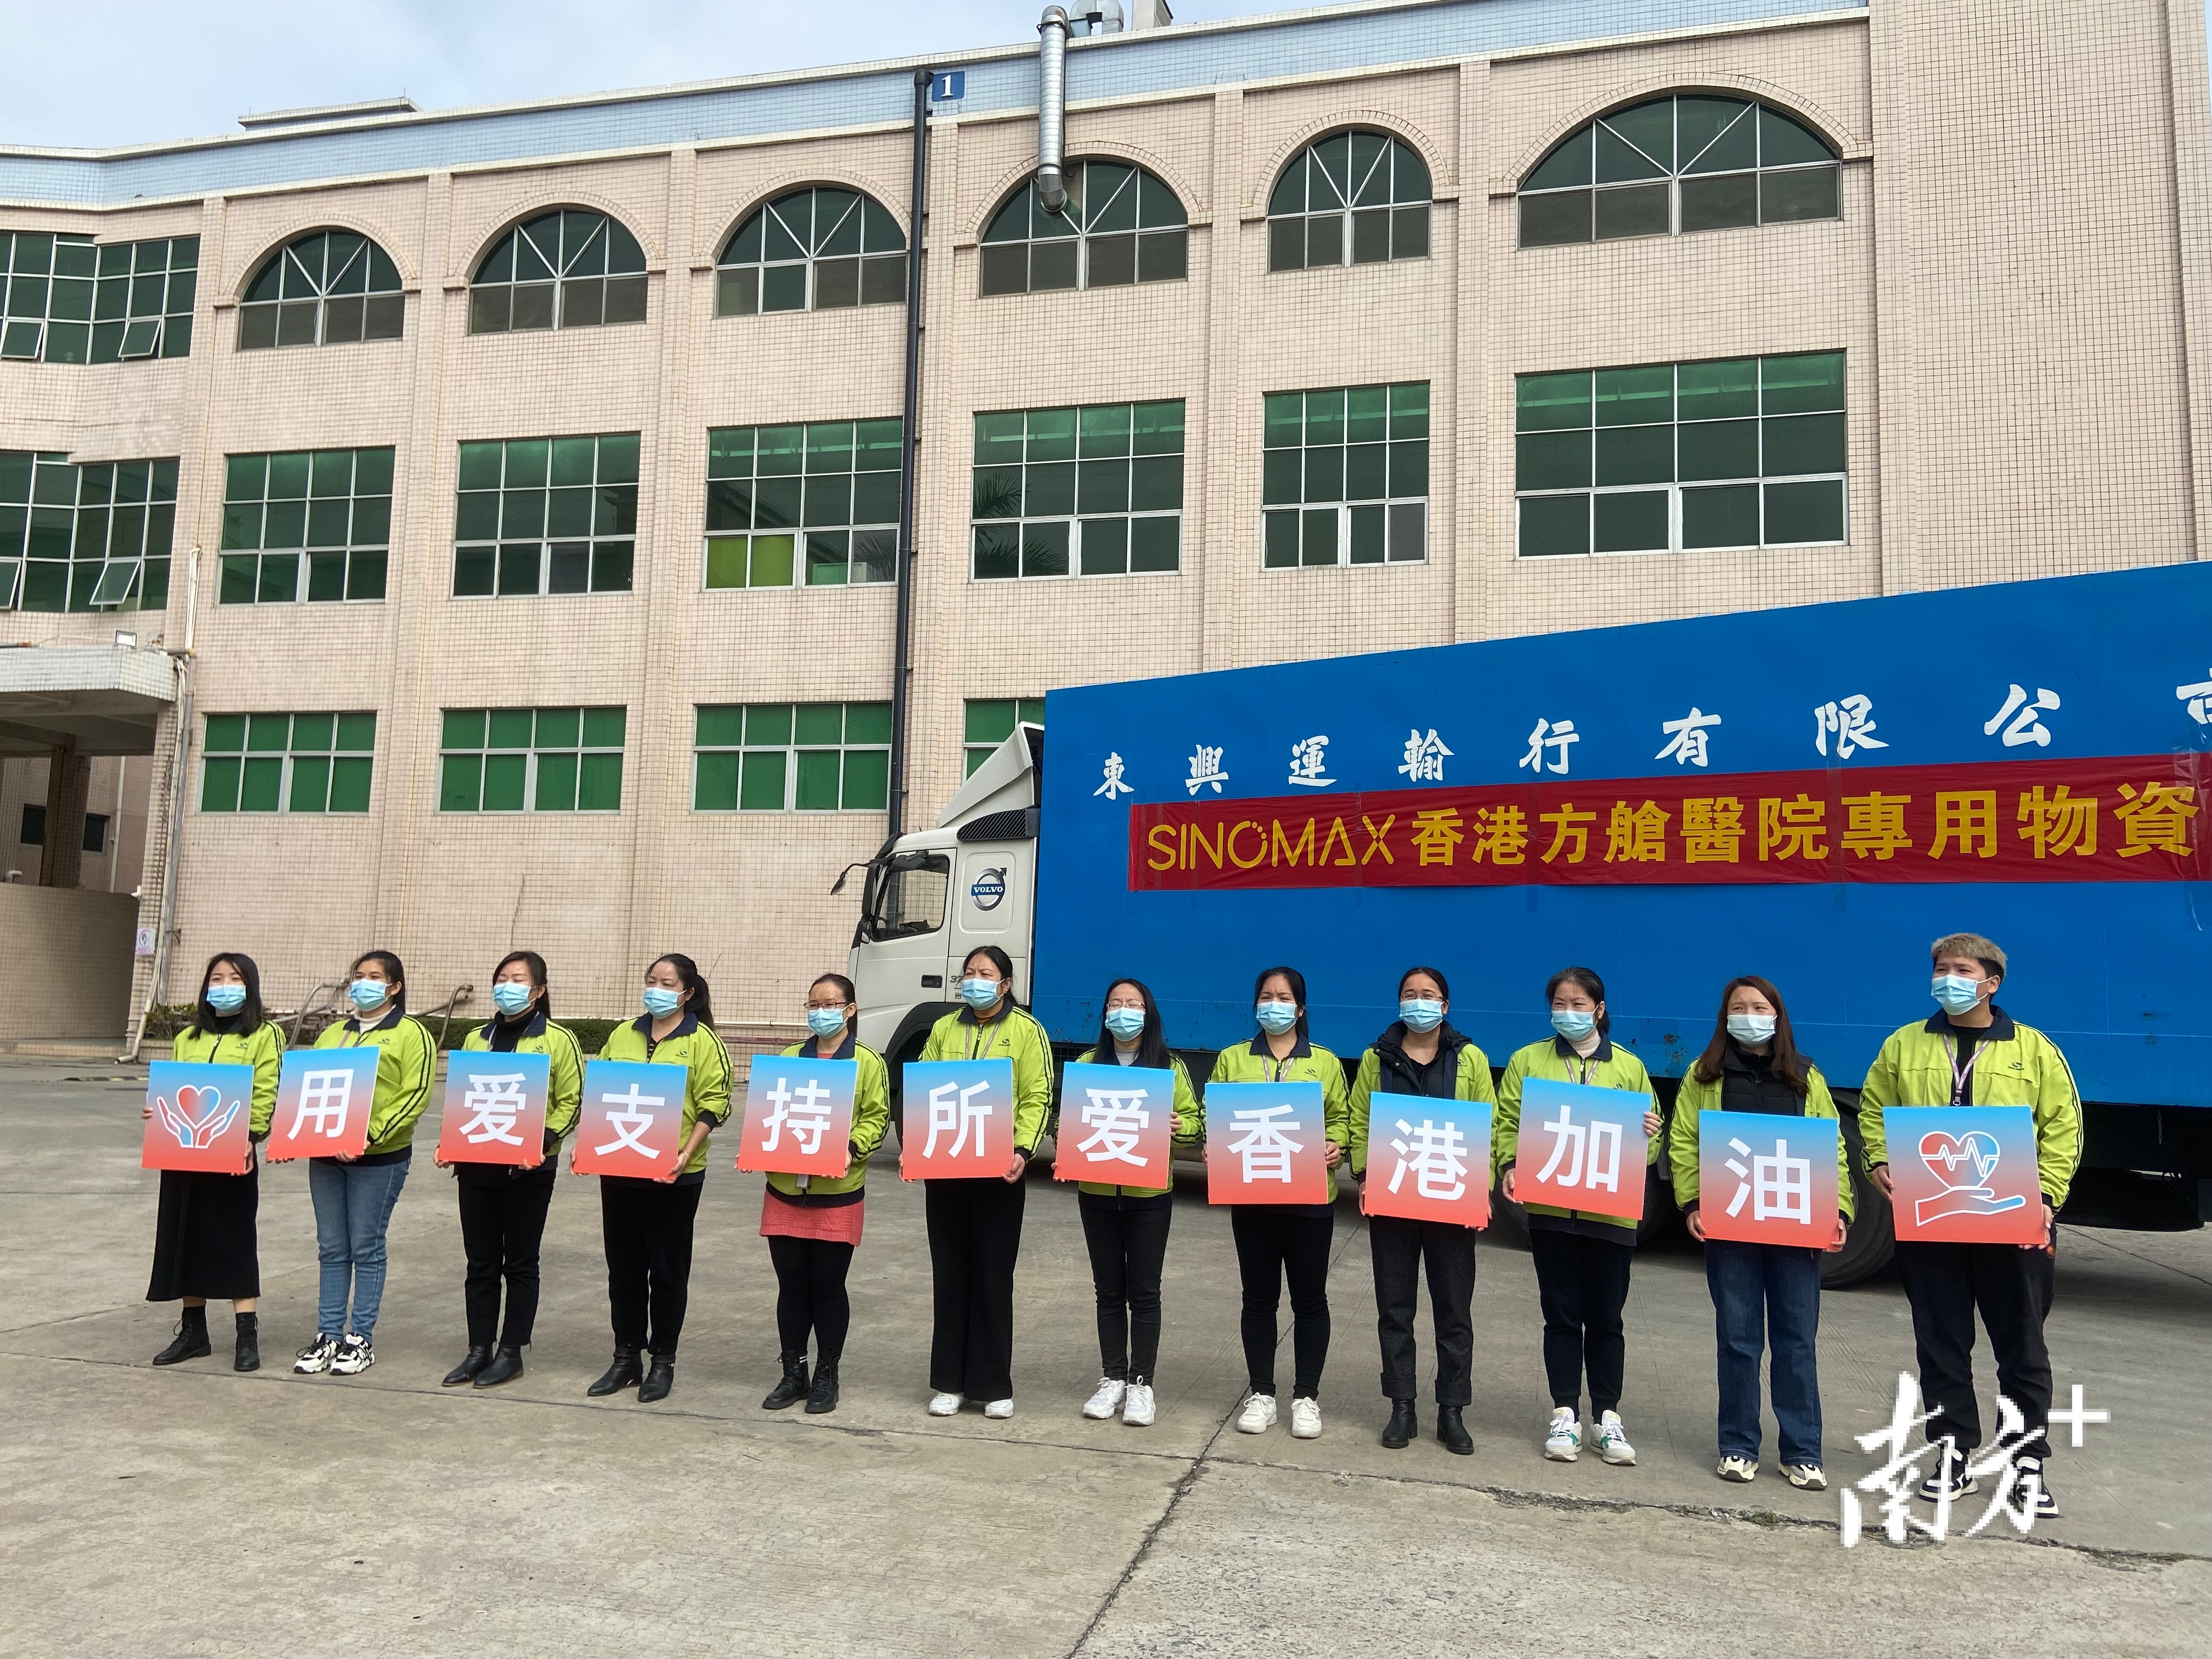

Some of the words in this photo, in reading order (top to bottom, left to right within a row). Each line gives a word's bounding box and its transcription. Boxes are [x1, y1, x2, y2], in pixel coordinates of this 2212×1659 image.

[941, 75, 953, 97] 1
[1147, 814, 1396, 871] SINOMAX
[1412, 781, 2200, 867] 香港方艙醫院專用物資
[287, 1068, 354, 1141] 用
[459, 1073, 527, 1147] 爱
[594, 1083, 665, 1160] 支
[761, 1077, 832, 1155] 持
[922, 1080, 993, 1159] 所
[1076, 1088, 1150, 1167] 爱
[1227, 1104, 1305, 1184] 香
[1387, 1119, 1468, 1201] 港
[1536, 1105, 1623, 1193] 加
[1724, 1137, 1811, 1225] 油
